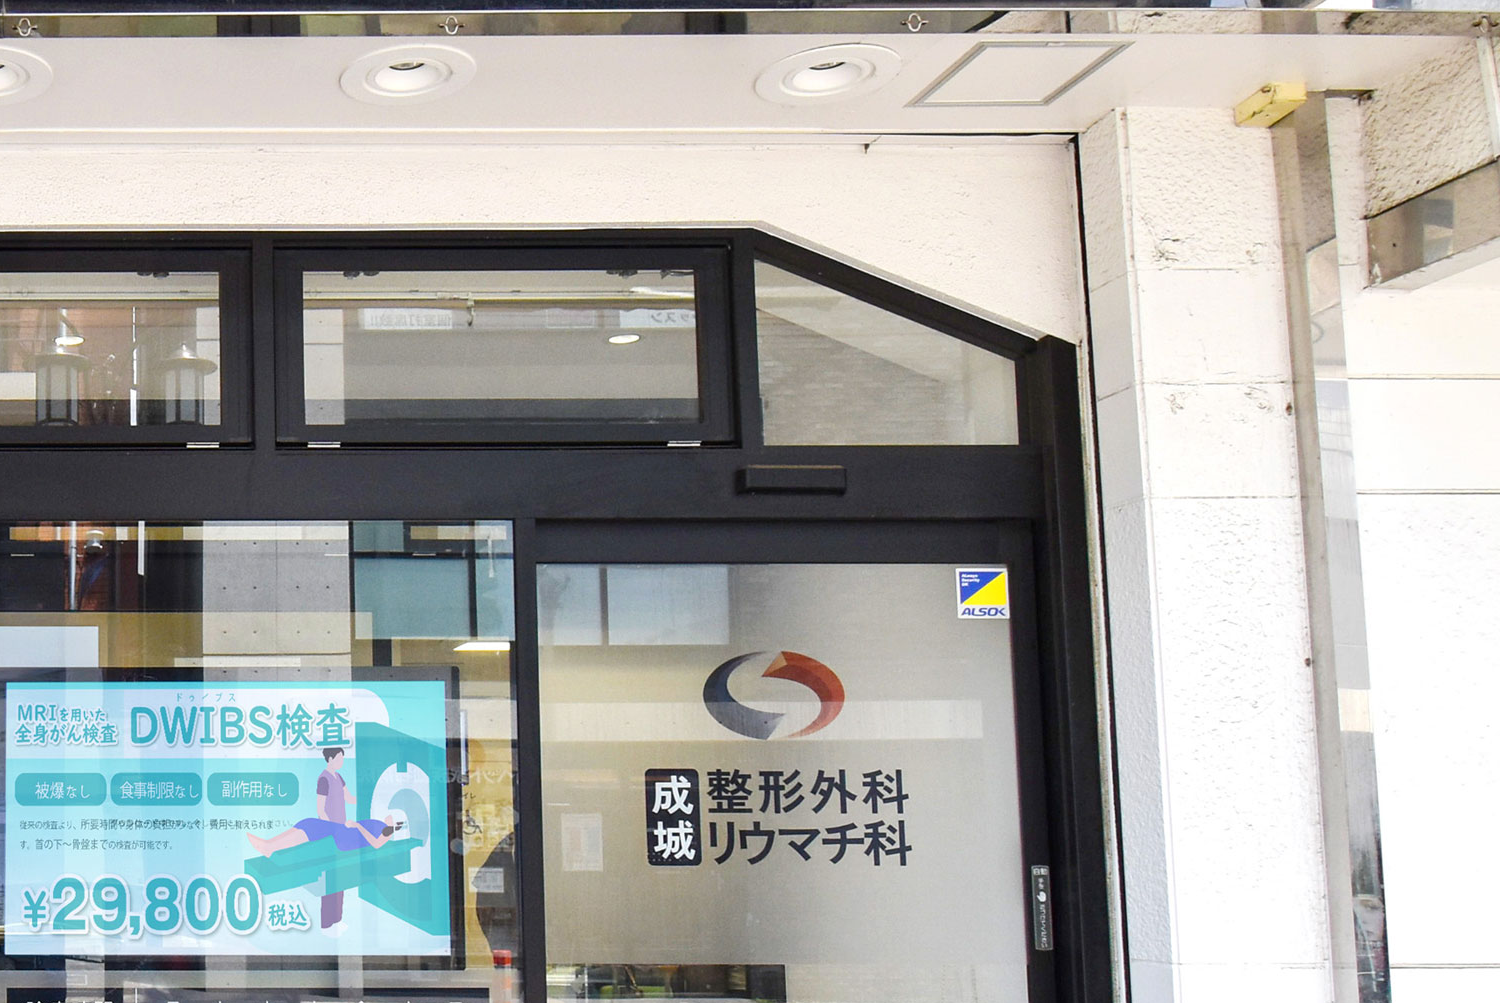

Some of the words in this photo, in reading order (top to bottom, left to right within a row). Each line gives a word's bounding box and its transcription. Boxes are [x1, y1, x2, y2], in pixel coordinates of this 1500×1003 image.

[961, 607, 1006, 617] ALSOK
[17, 704, 106, 722] MRIを用いた
[15, 723, 117, 744] 全身がん検査
[130, 702, 351, 747] DWIBS検査
[35, 781, 91, 799] 被爆なし
[120, 780, 199, 799] 食事制限なし
[221, 780, 288, 798] 副作用なし
[707, 769, 909, 814] 整形外科
[652, 775, 696, 860] 成城
[708, 820, 913, 866] リウマチ科
[24, 877, 260, 936] ¥29,800
[268, 903, 308, 927] 税込
